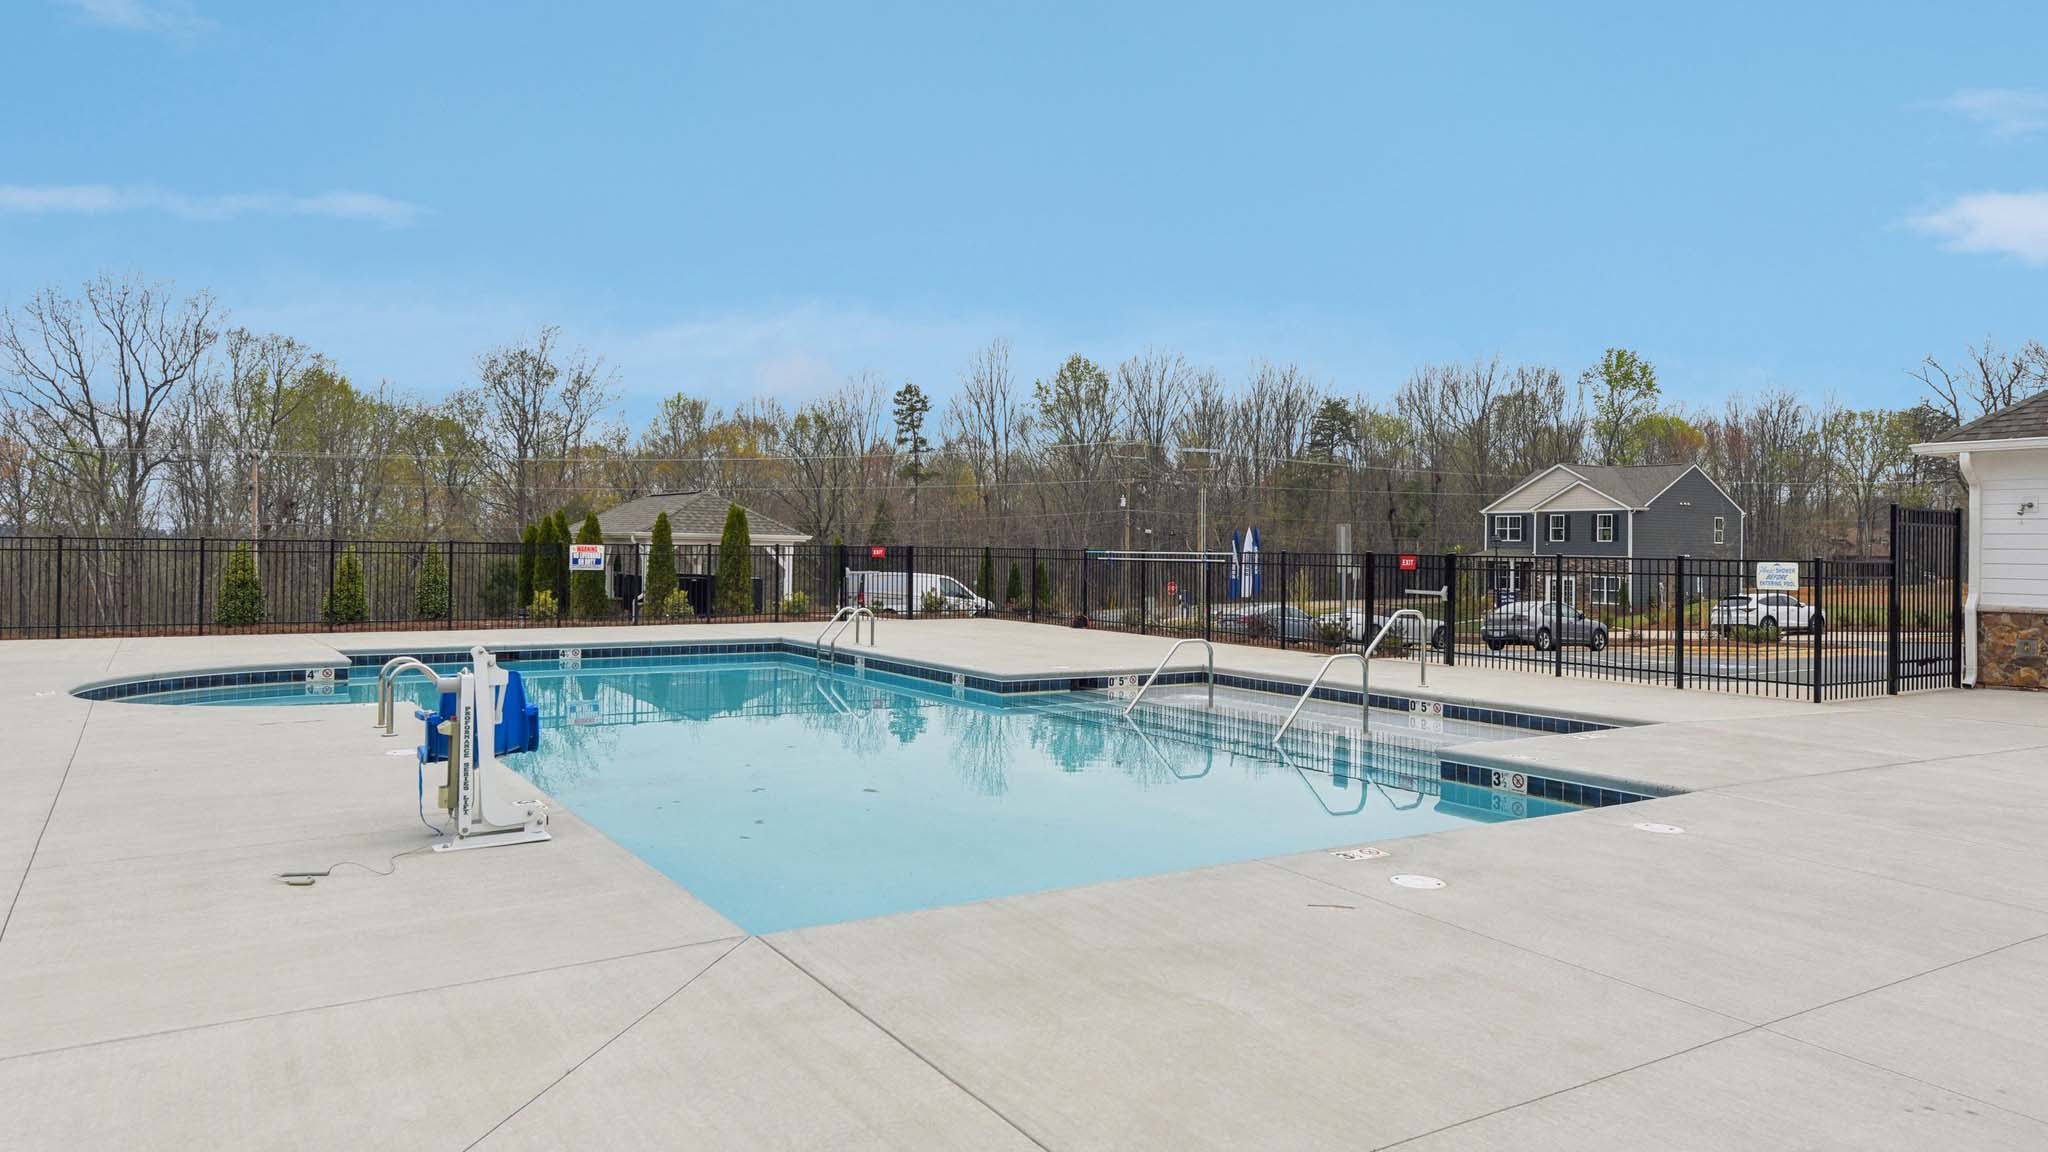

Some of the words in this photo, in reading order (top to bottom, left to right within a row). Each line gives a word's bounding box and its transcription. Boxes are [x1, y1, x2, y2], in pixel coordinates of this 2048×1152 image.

[307, 670, 314, 680] 4
[1119, 676, 1125, 686] 5
[1421, 701, 1427, 713] 5
[463, 762, 471, 791] SERIES
[1493, 771, 1501, 787] 3
[463, 794, 471, 816] LIFT
